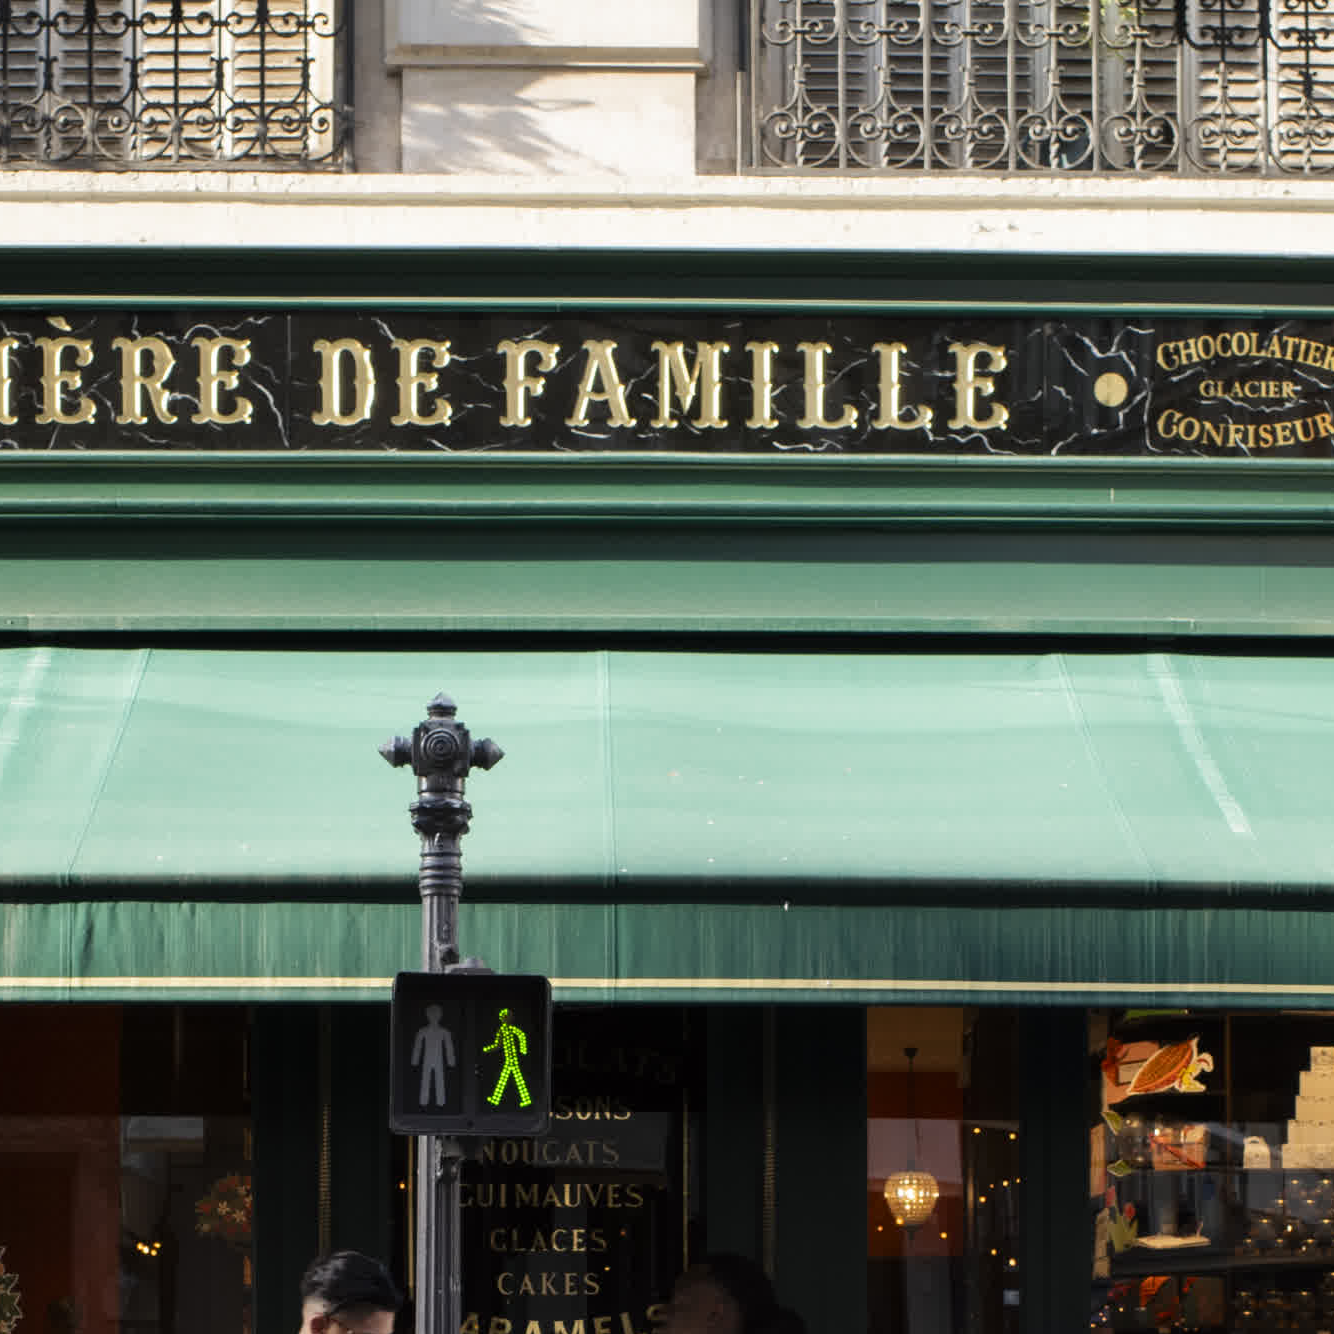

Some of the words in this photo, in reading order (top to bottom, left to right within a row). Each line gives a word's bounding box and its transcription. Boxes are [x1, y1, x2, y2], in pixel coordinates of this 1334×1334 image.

[312, 338, 453, 427] DE
[495, 339, 1011, 431] FAMILLE
[1198, 379, 1298, 399] GLACIER
[490, 1227, 609, 1253] GLACES
[497, 1272, 601, 1297] CAKES
